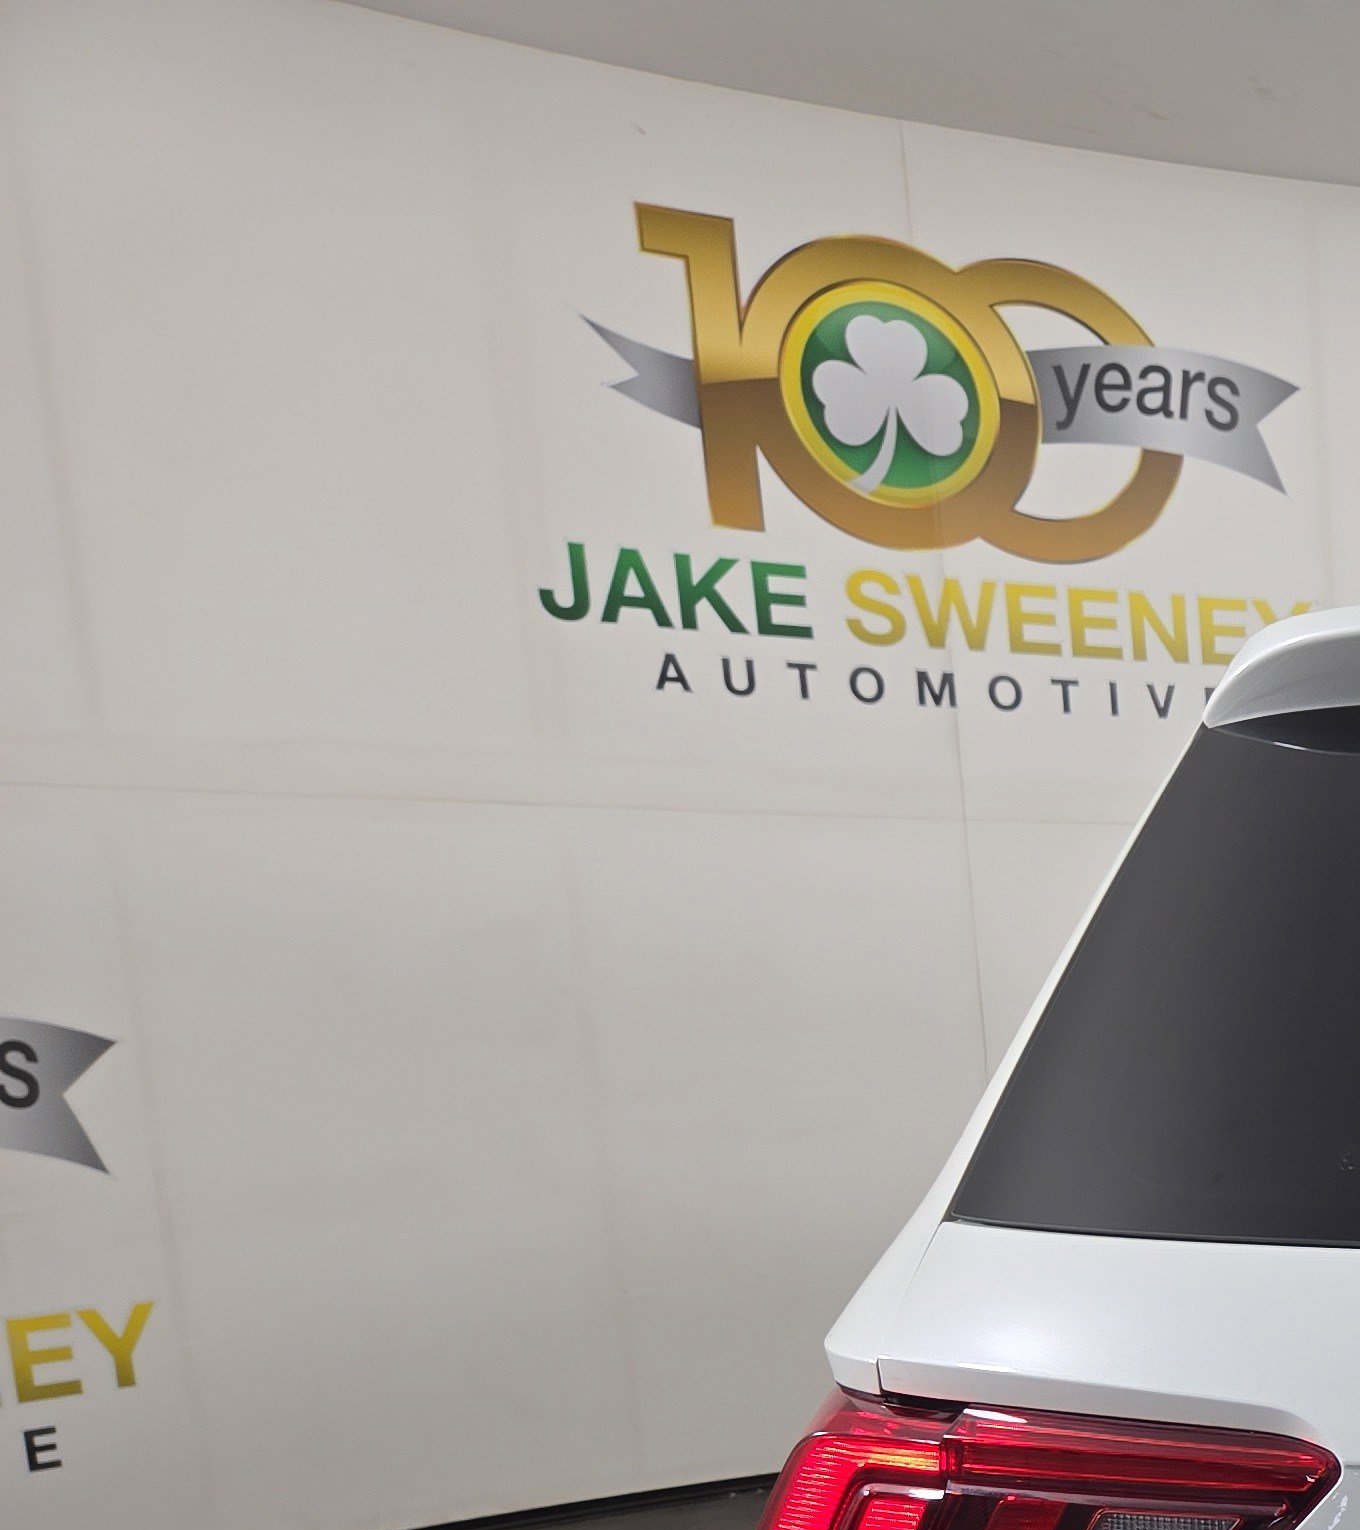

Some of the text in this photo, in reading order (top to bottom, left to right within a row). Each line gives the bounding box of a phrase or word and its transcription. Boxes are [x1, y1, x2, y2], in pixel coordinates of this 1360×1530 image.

[1052, 356, 1241, 433] years
[539, 541, 1311, 666] JAKE SWEENE
[655, 652, 1215, 719] AUTOMOTIV
[0, 1300, 155, 1403] EY
